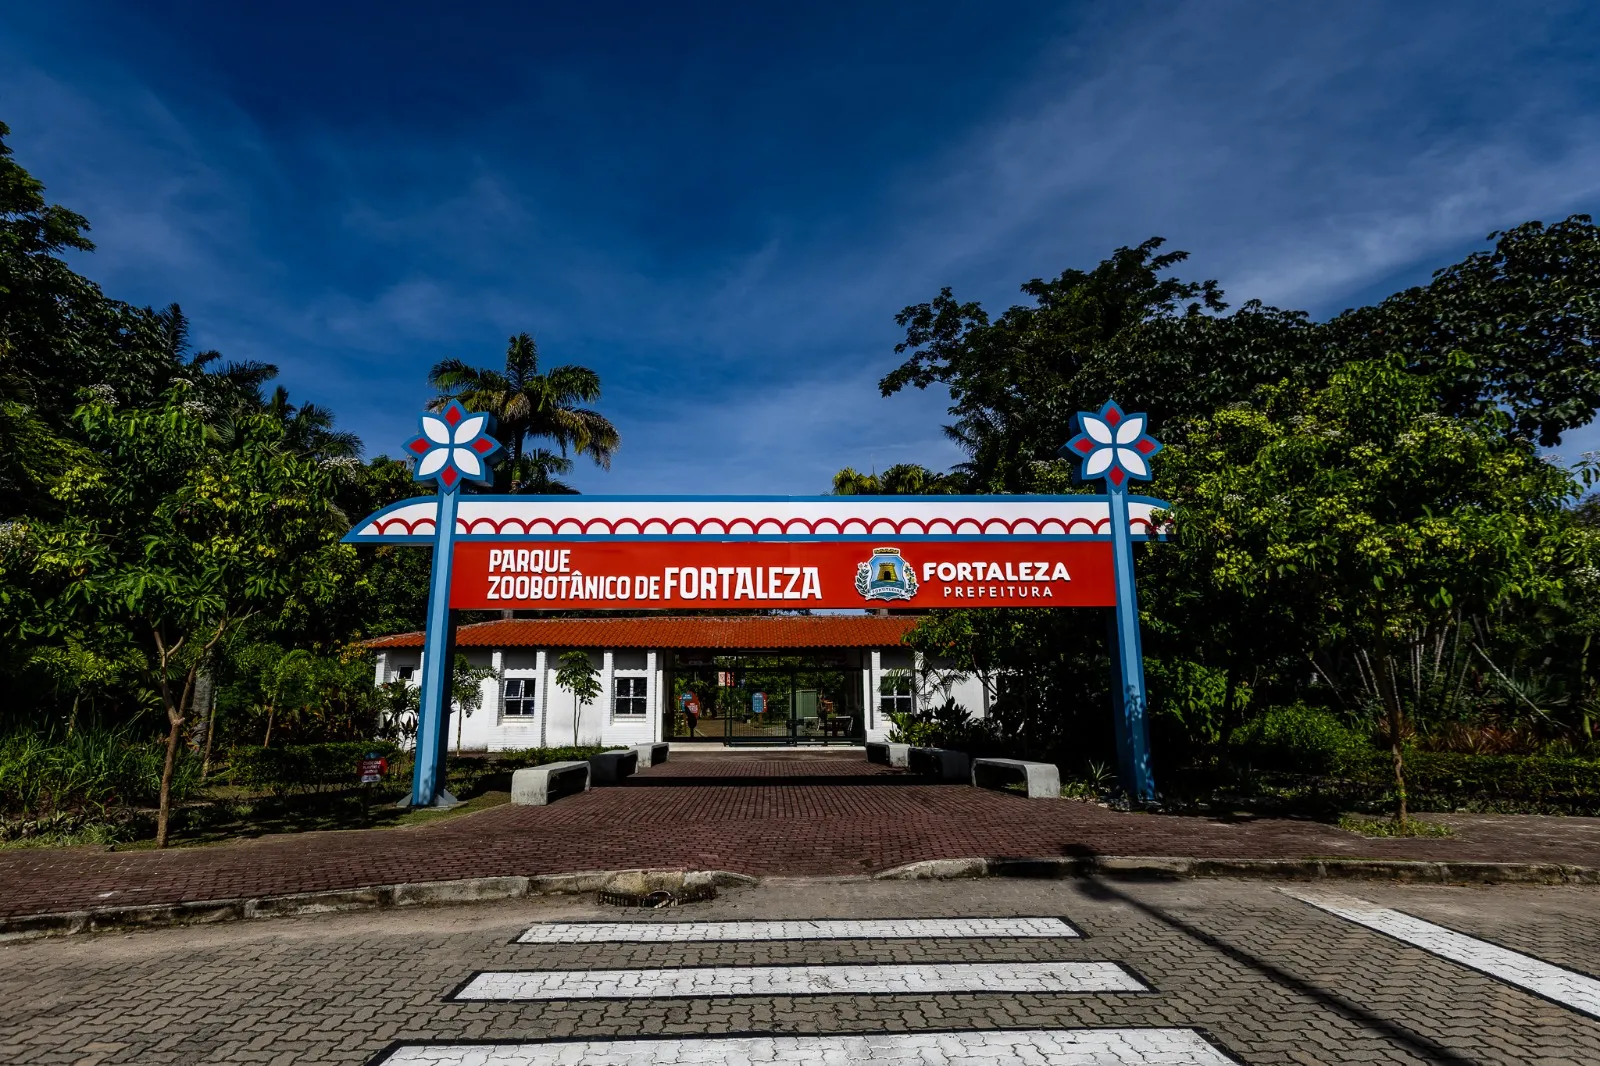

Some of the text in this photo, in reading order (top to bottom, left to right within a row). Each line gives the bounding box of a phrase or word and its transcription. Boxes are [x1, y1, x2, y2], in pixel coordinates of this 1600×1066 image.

[488, 549, 572, 574] PARQUE
[922, 561, 1072, 582] FORTALEZA
[486, 566, 823, 600] ZOOBOTÂNICO DE FORTALEZA
[943, 586, 1054, 598] PREFEITURA
